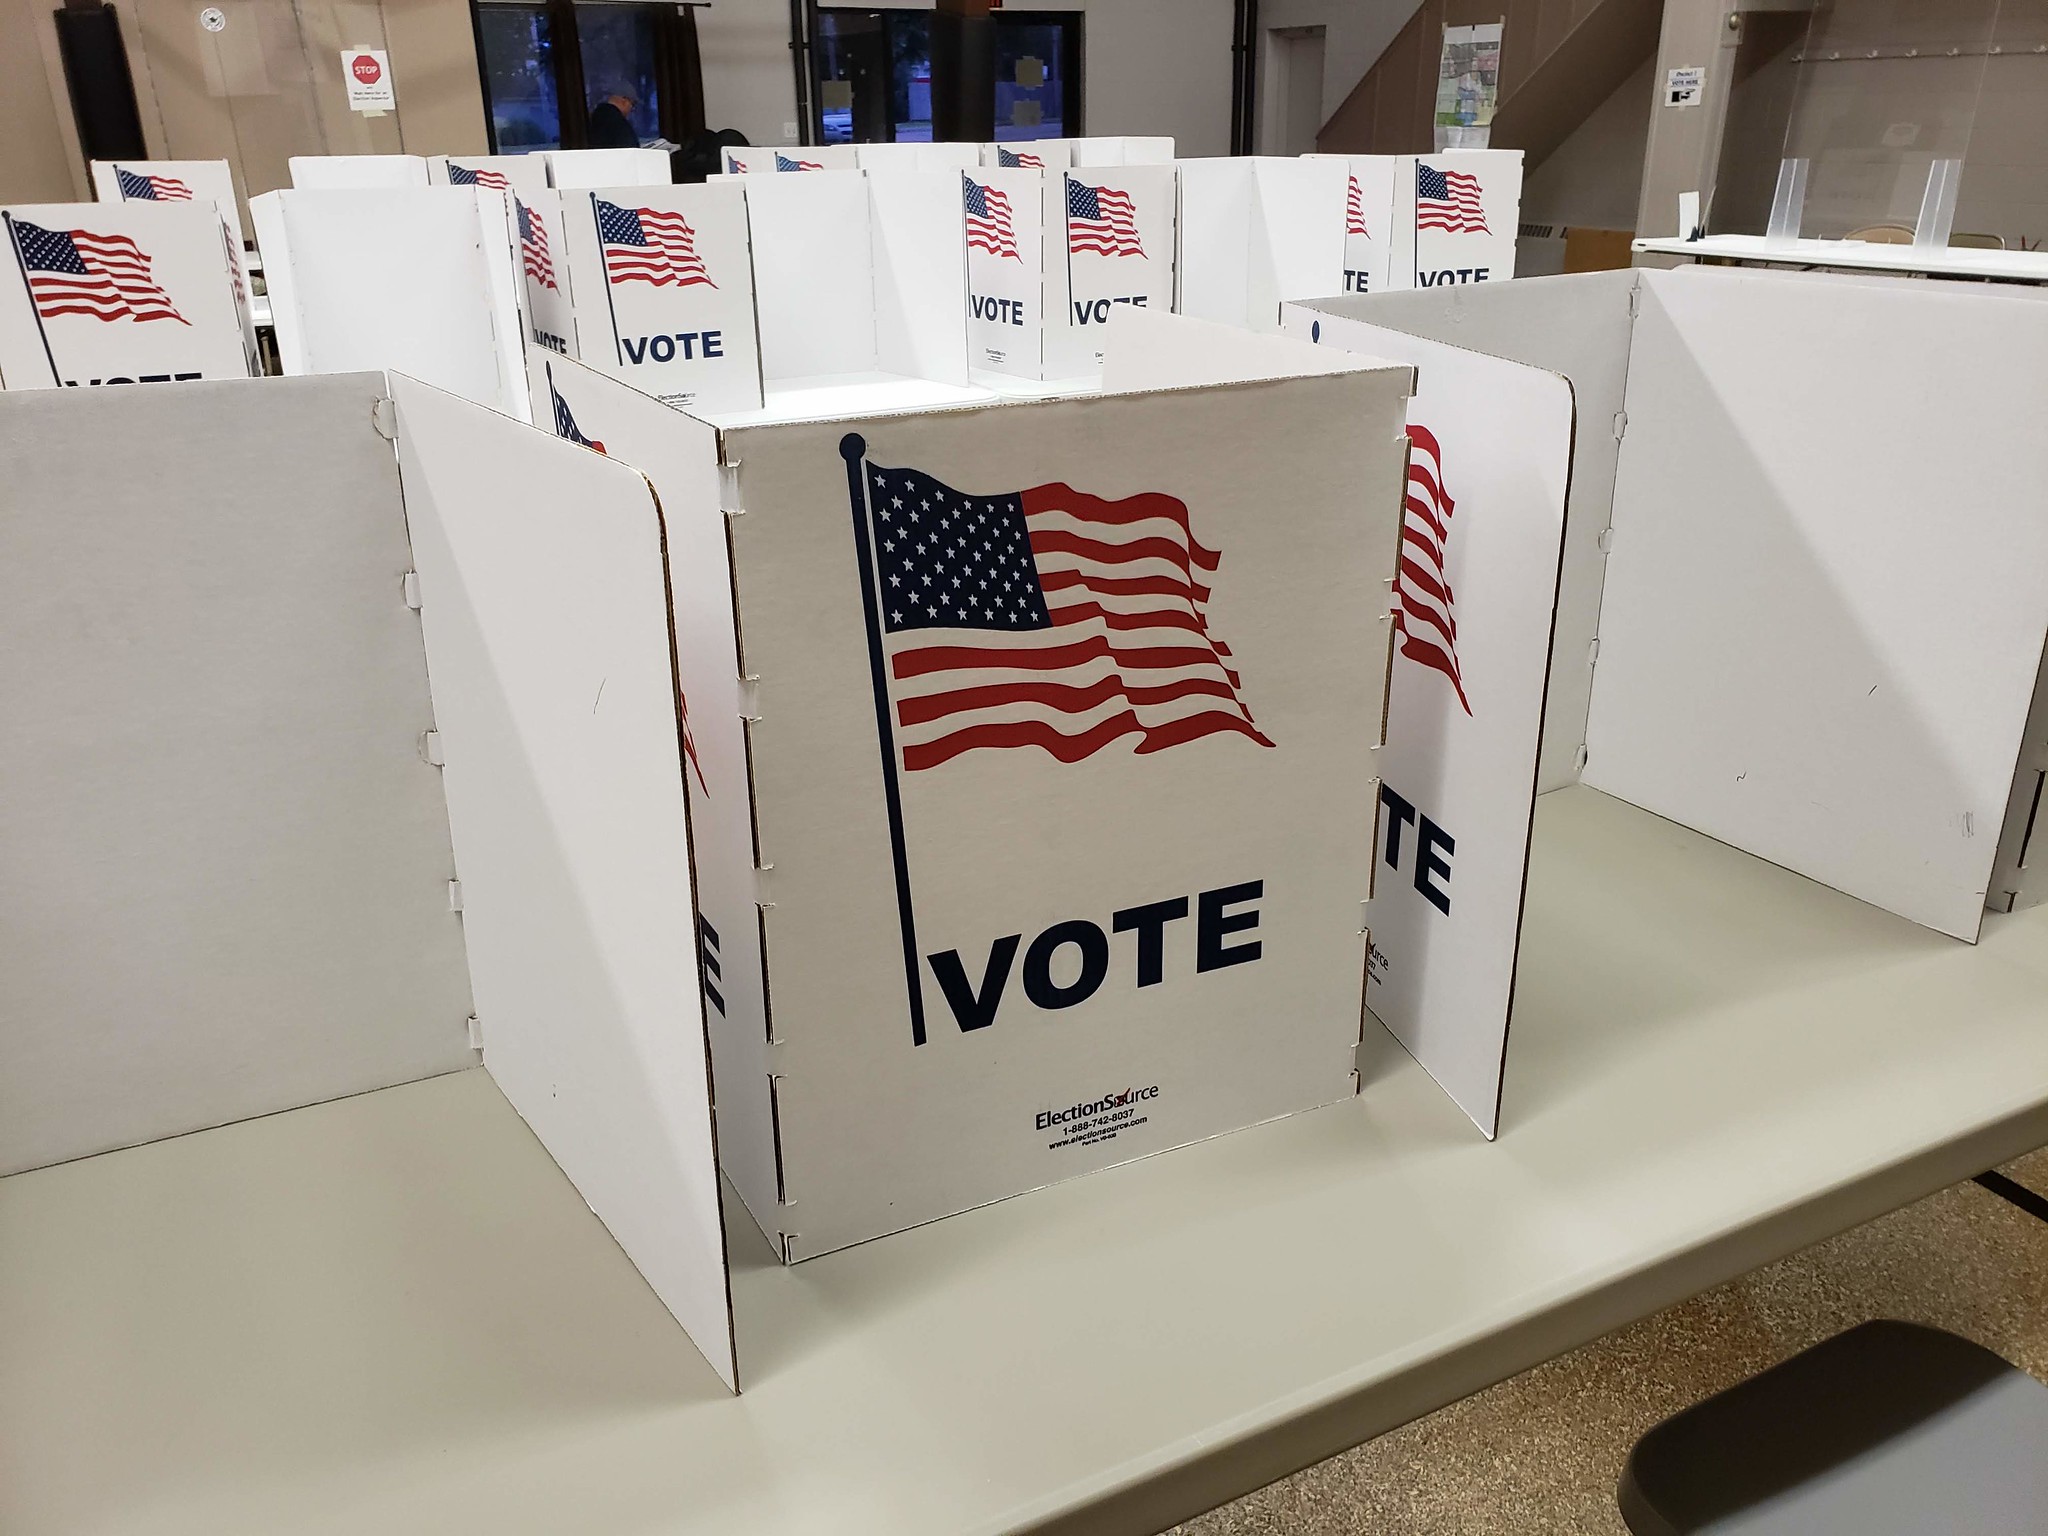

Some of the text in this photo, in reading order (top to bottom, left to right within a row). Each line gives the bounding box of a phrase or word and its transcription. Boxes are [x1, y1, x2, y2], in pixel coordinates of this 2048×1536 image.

[354, 65, 378, 75] STOP
[1344, 269, 1369, 293] TE
[1419, 268, 1490, 288] VOTE
[971, 294, 1024, 327] VOTE
[622, 330, 724, 365] VOTE
[1381, 782, 1456, 918] TE
[926, 879, 1264, 1033] VOTE
[1035, 1085, 1159, 1131] ElectionSource
[1062, 1108, 1135, 1136] 1-888-742-8037
[1048, 1115, 1148, 1150] www.electionsource.com
